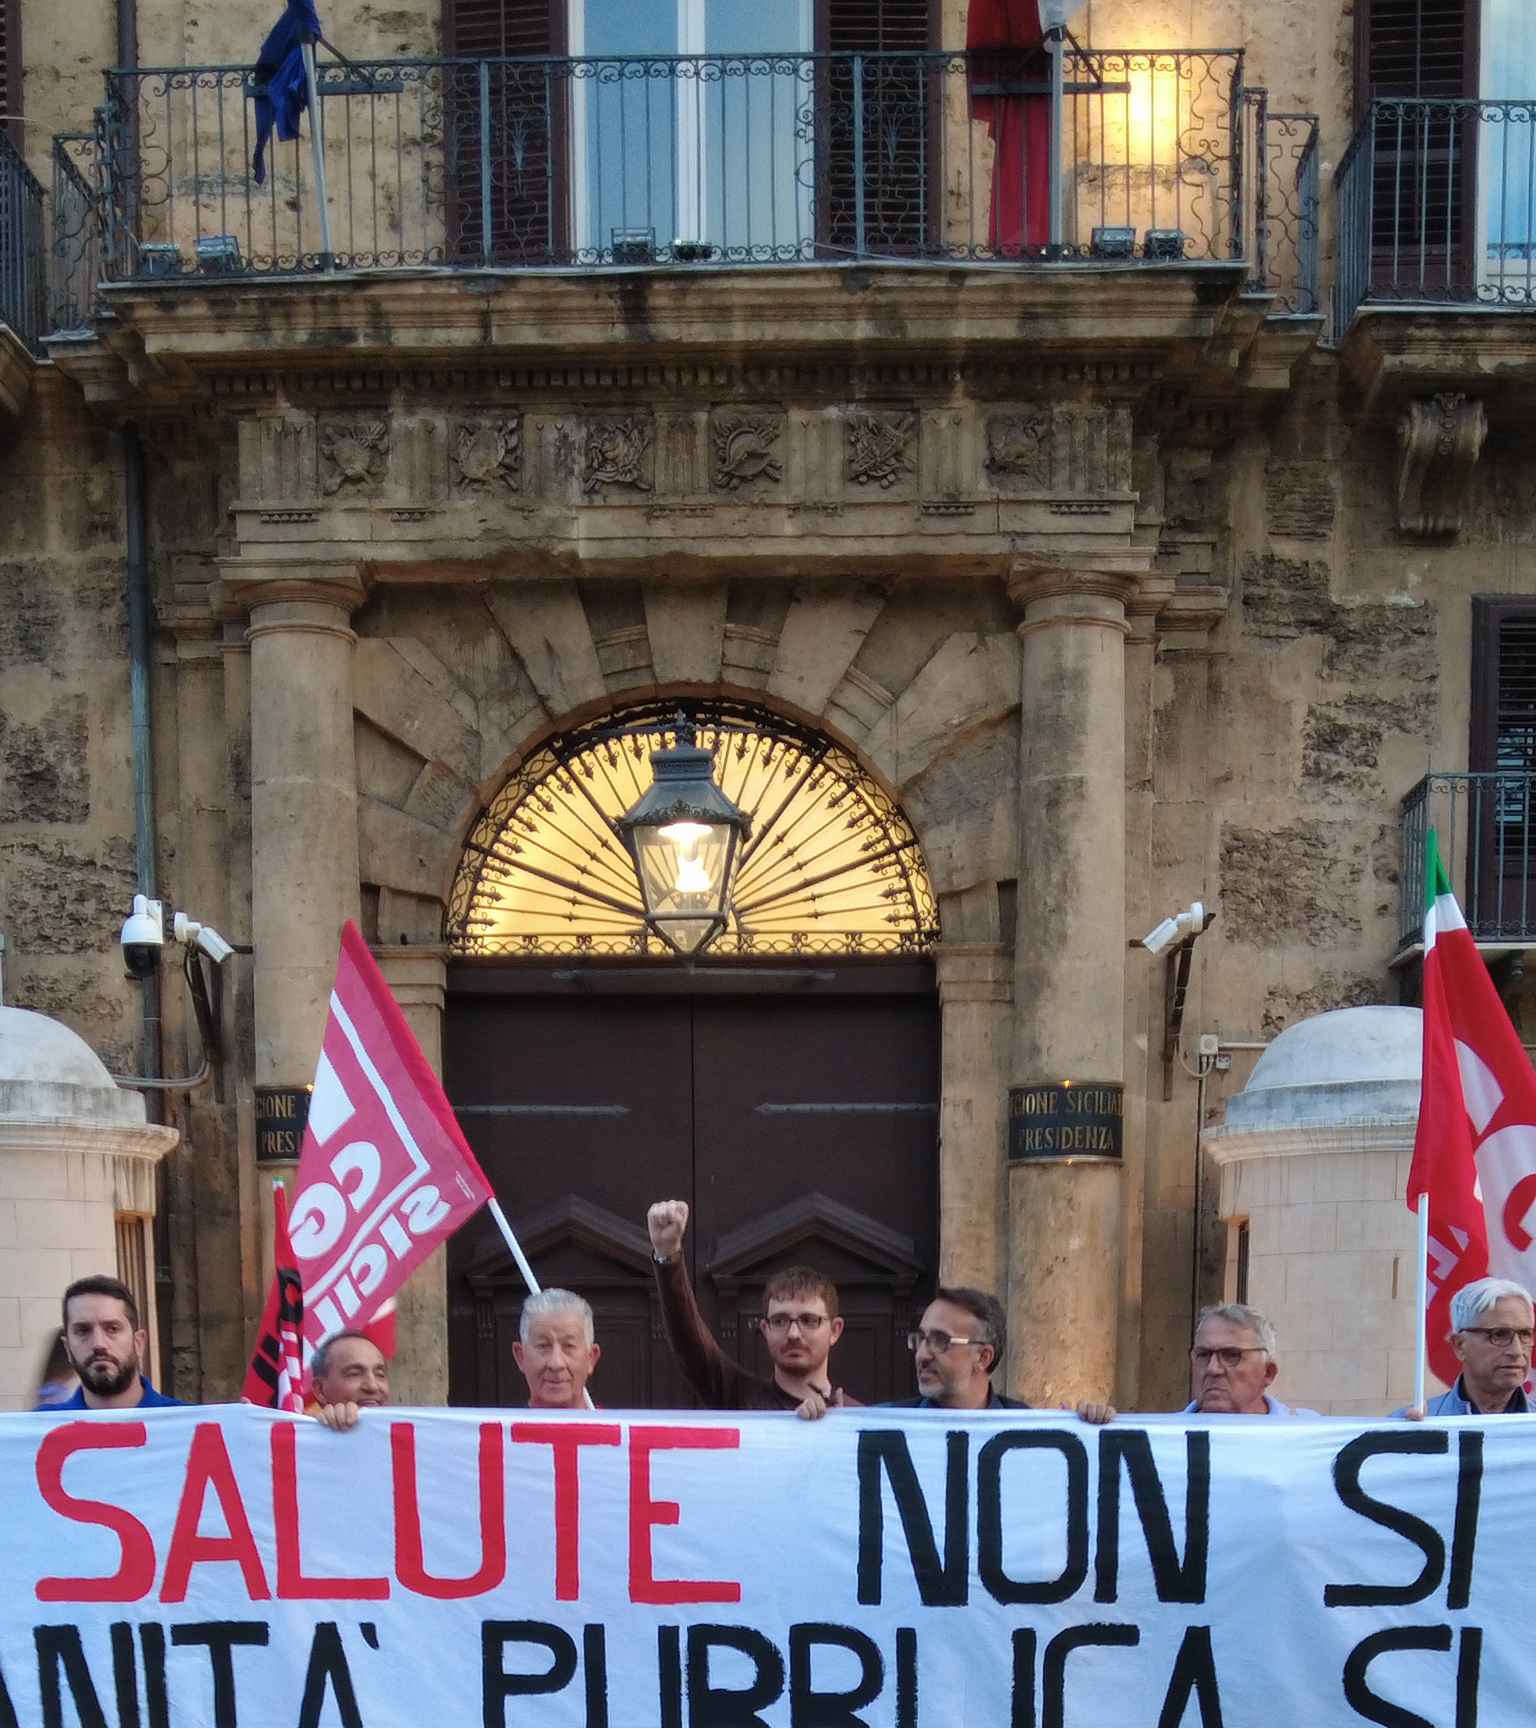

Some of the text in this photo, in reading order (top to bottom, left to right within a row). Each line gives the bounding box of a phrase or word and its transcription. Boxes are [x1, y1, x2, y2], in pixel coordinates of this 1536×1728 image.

[1011, 1092, 1058, 1116] GIONE
[261, 1130, 304, 1153] PRESI
[1018, 1125, 1114, 1152] PRESIDENZA
[36, 1422, 741, 1604] SALUTE
[857, 1430, 1210, 1606] NON
[1323, 1430, 1484, 1610] SI
